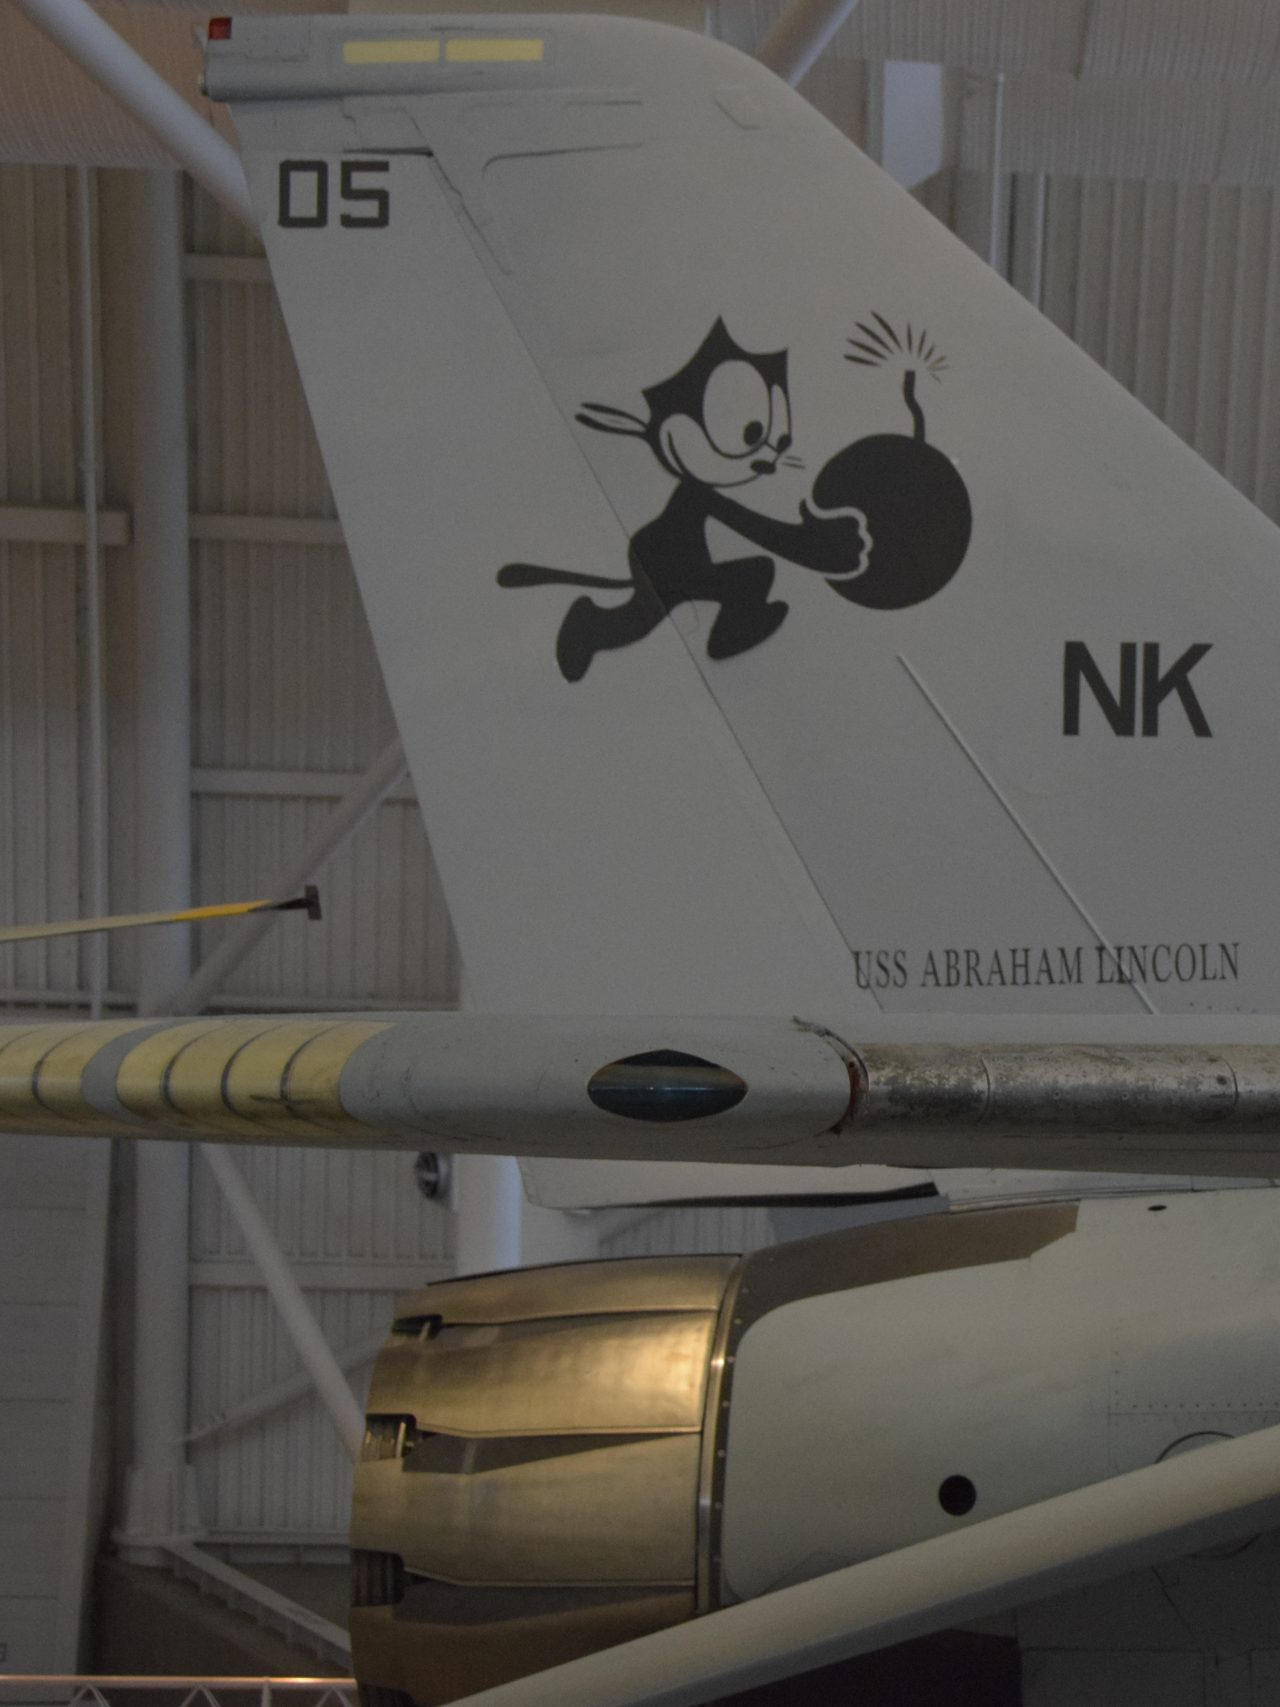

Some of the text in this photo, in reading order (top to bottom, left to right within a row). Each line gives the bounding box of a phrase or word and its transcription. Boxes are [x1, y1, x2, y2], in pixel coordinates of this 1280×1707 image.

[278, 159, 391, 229] 05
[1062, 640, 1215, 738] NK
[854, 942, 1241, 990] USS ABRAHAM LINCOLN
